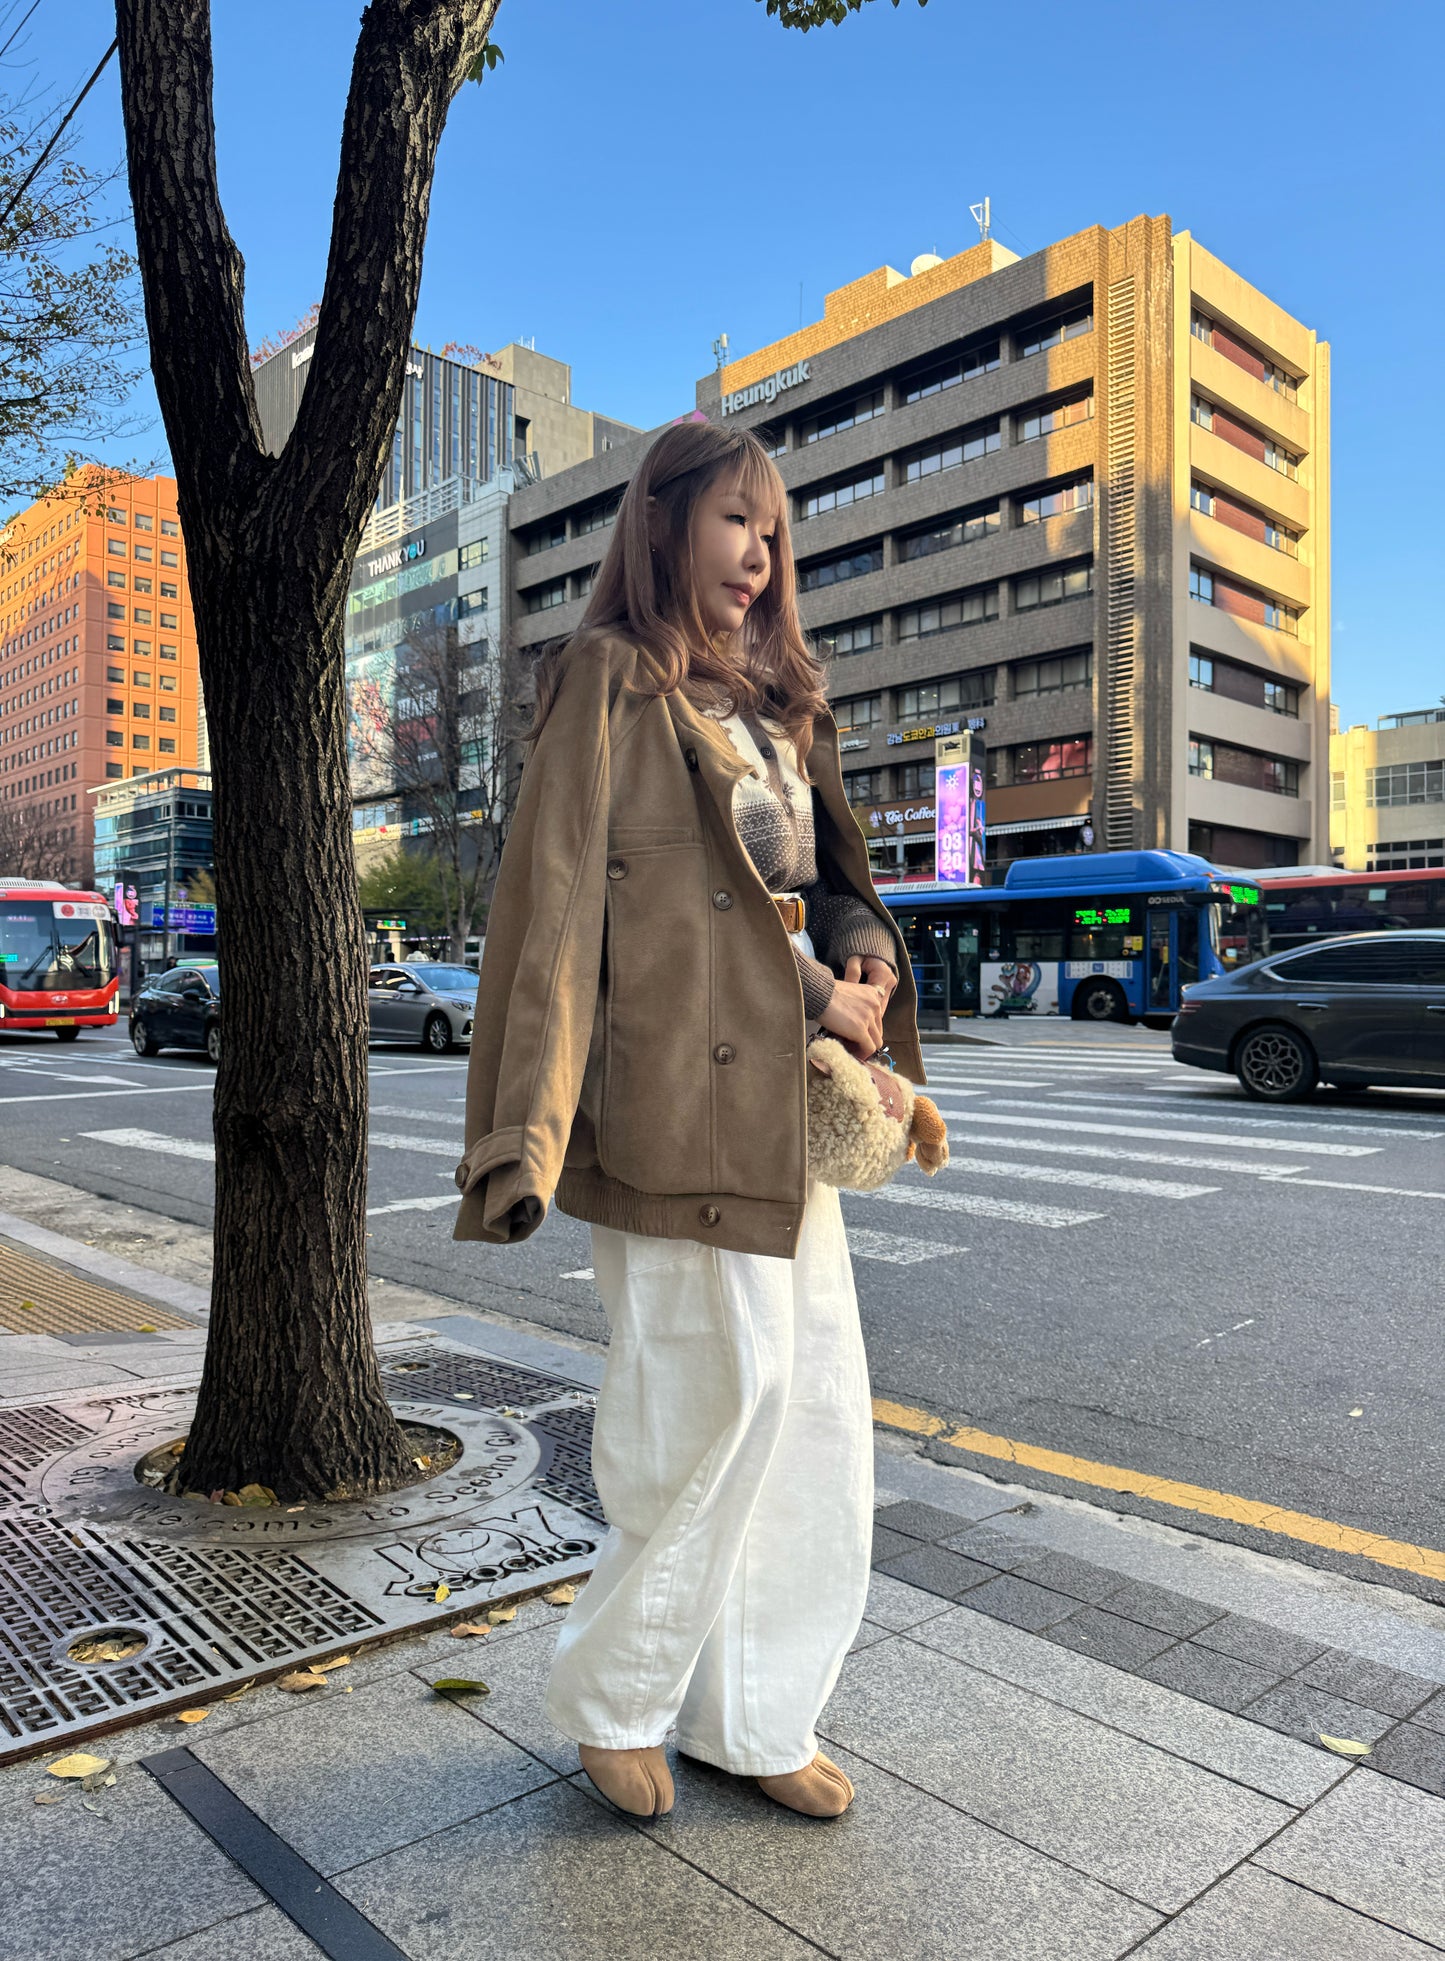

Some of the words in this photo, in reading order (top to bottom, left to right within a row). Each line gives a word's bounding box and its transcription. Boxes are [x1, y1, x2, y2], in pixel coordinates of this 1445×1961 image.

[721, 360, 811, 417] Heungkuk
[367, 549, 402, 578] THANK
[884, 809, 904, 826] The
[942, 832, 962, 851] 03
[942, 851, 962, 871] 20
[361, 1505, 410, 1521] to
[424, 1454, 518, 1504] Seocho
[485, 1430, 516, 1447] Gu
